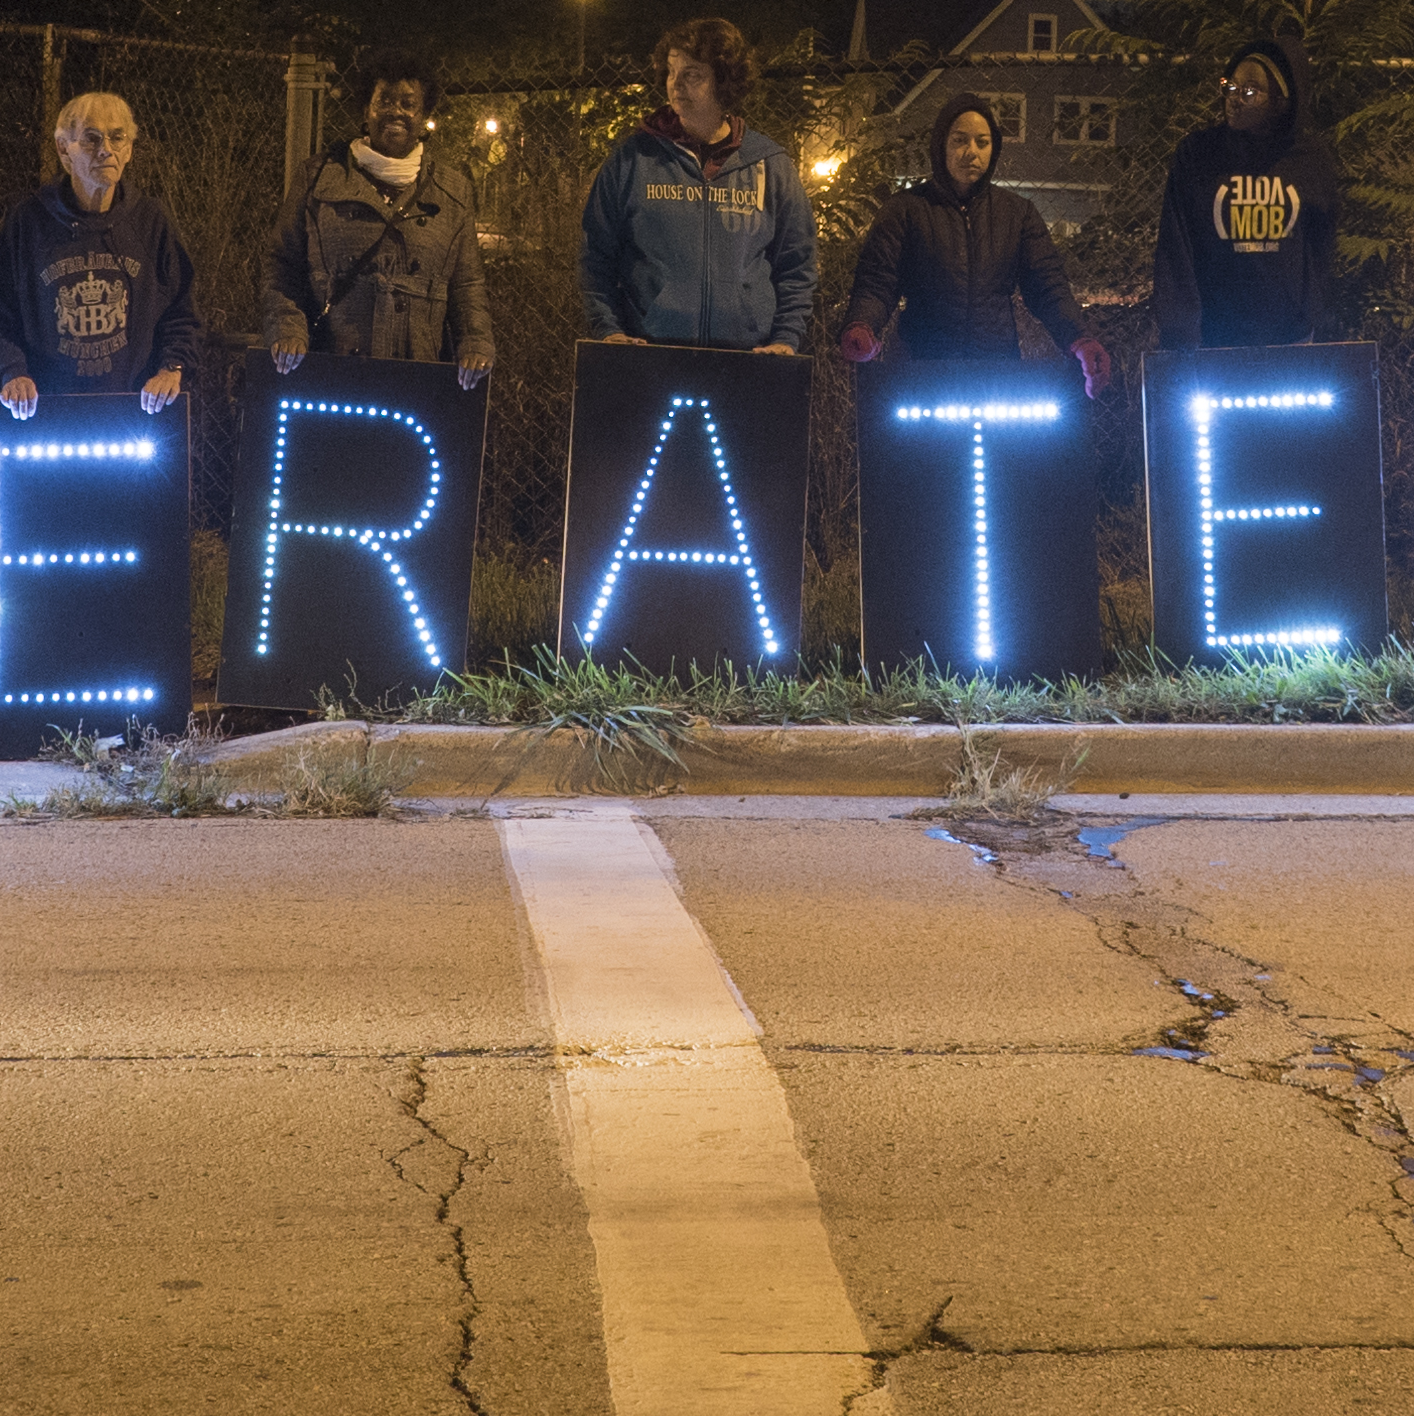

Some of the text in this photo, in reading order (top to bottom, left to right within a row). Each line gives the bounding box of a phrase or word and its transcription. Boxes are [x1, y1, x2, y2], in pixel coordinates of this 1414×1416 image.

[646, 184, 757, 206] HOUSE ON THE ROCK
[1230, 205, 1285, 240] MOB
